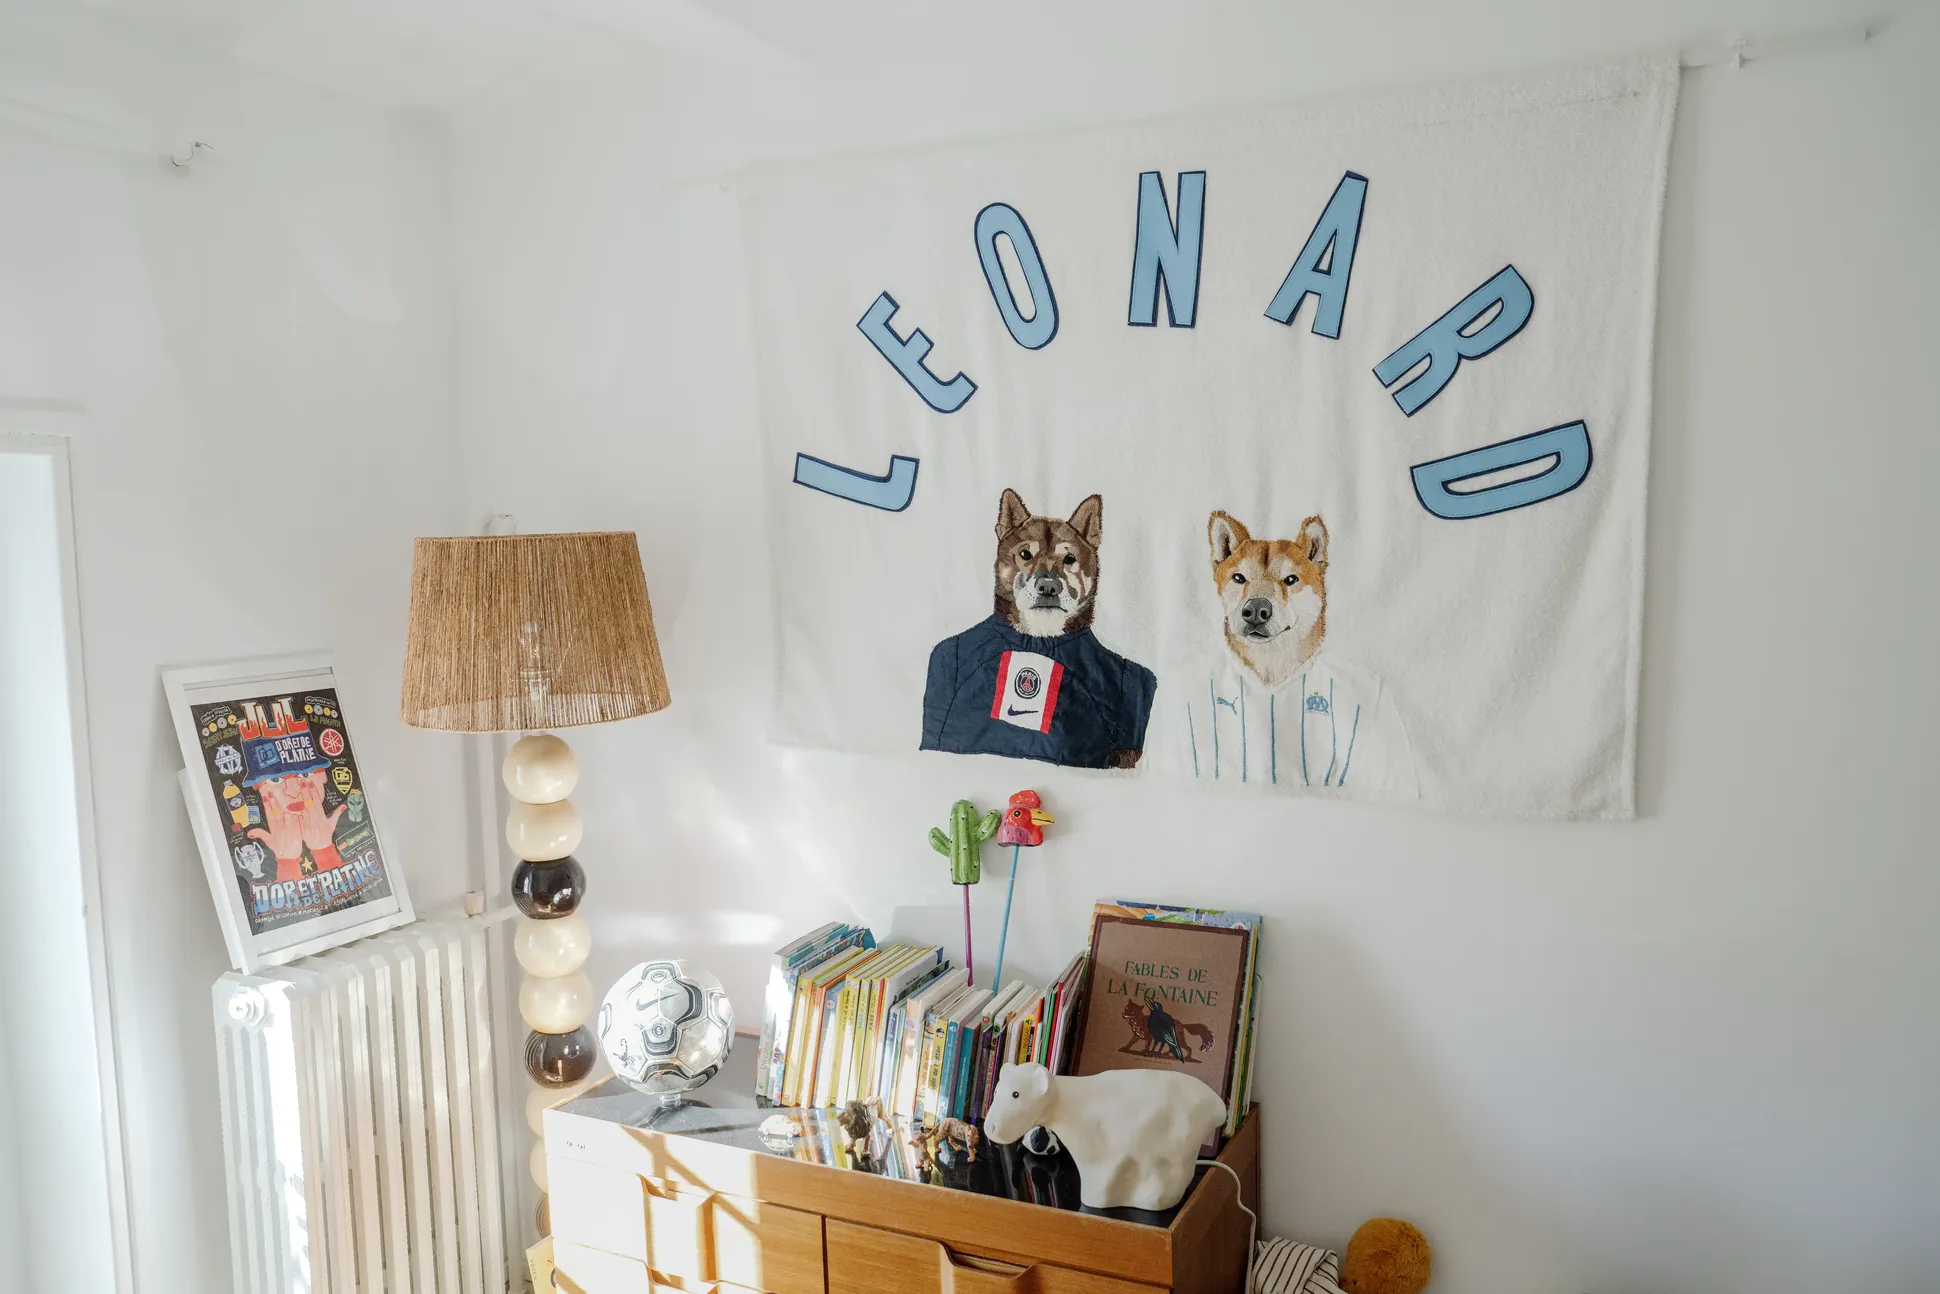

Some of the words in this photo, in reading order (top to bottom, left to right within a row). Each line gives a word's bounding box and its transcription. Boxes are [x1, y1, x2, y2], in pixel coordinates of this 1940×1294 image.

[793, 170, 1593, 520] LEONARD
[236, 697, 309, 740] JUL
[280, 748, 316, 764] PLATINE
[252, 881, 300, 915] D'OR
[299, 877, 319, 896] ET
[318, 850, 381, 904] PLATINE
[1125, 961, 1179, 980] FABLES
[1188, 968, 1208, 983] DE
[1108, 979, 1128, 995] LA
[1135, 982, 1218, 1006] FONTAINE
